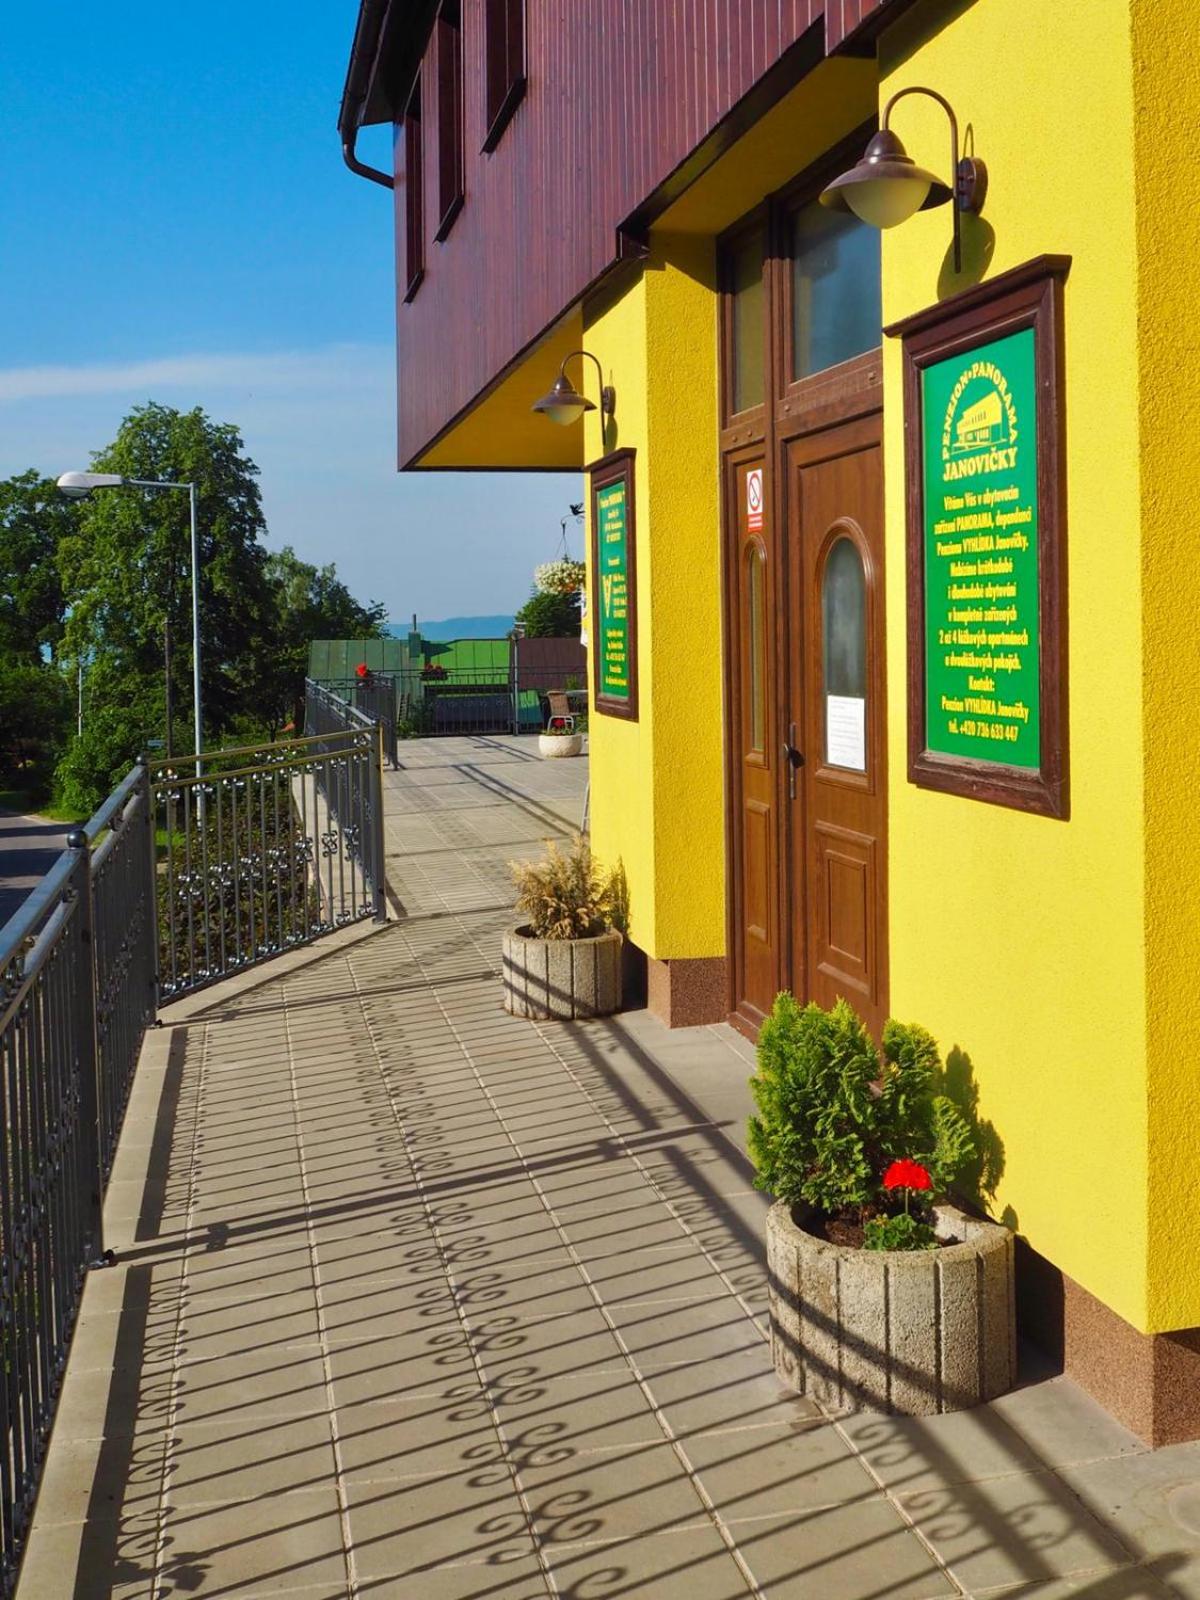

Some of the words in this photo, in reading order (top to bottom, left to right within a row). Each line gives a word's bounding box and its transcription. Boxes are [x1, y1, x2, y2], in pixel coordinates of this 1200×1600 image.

[943, 446, 1018, 481] JANOVIČKY
[939, 629, 944, 645] 2
[952, 629, 957, 644] 4
